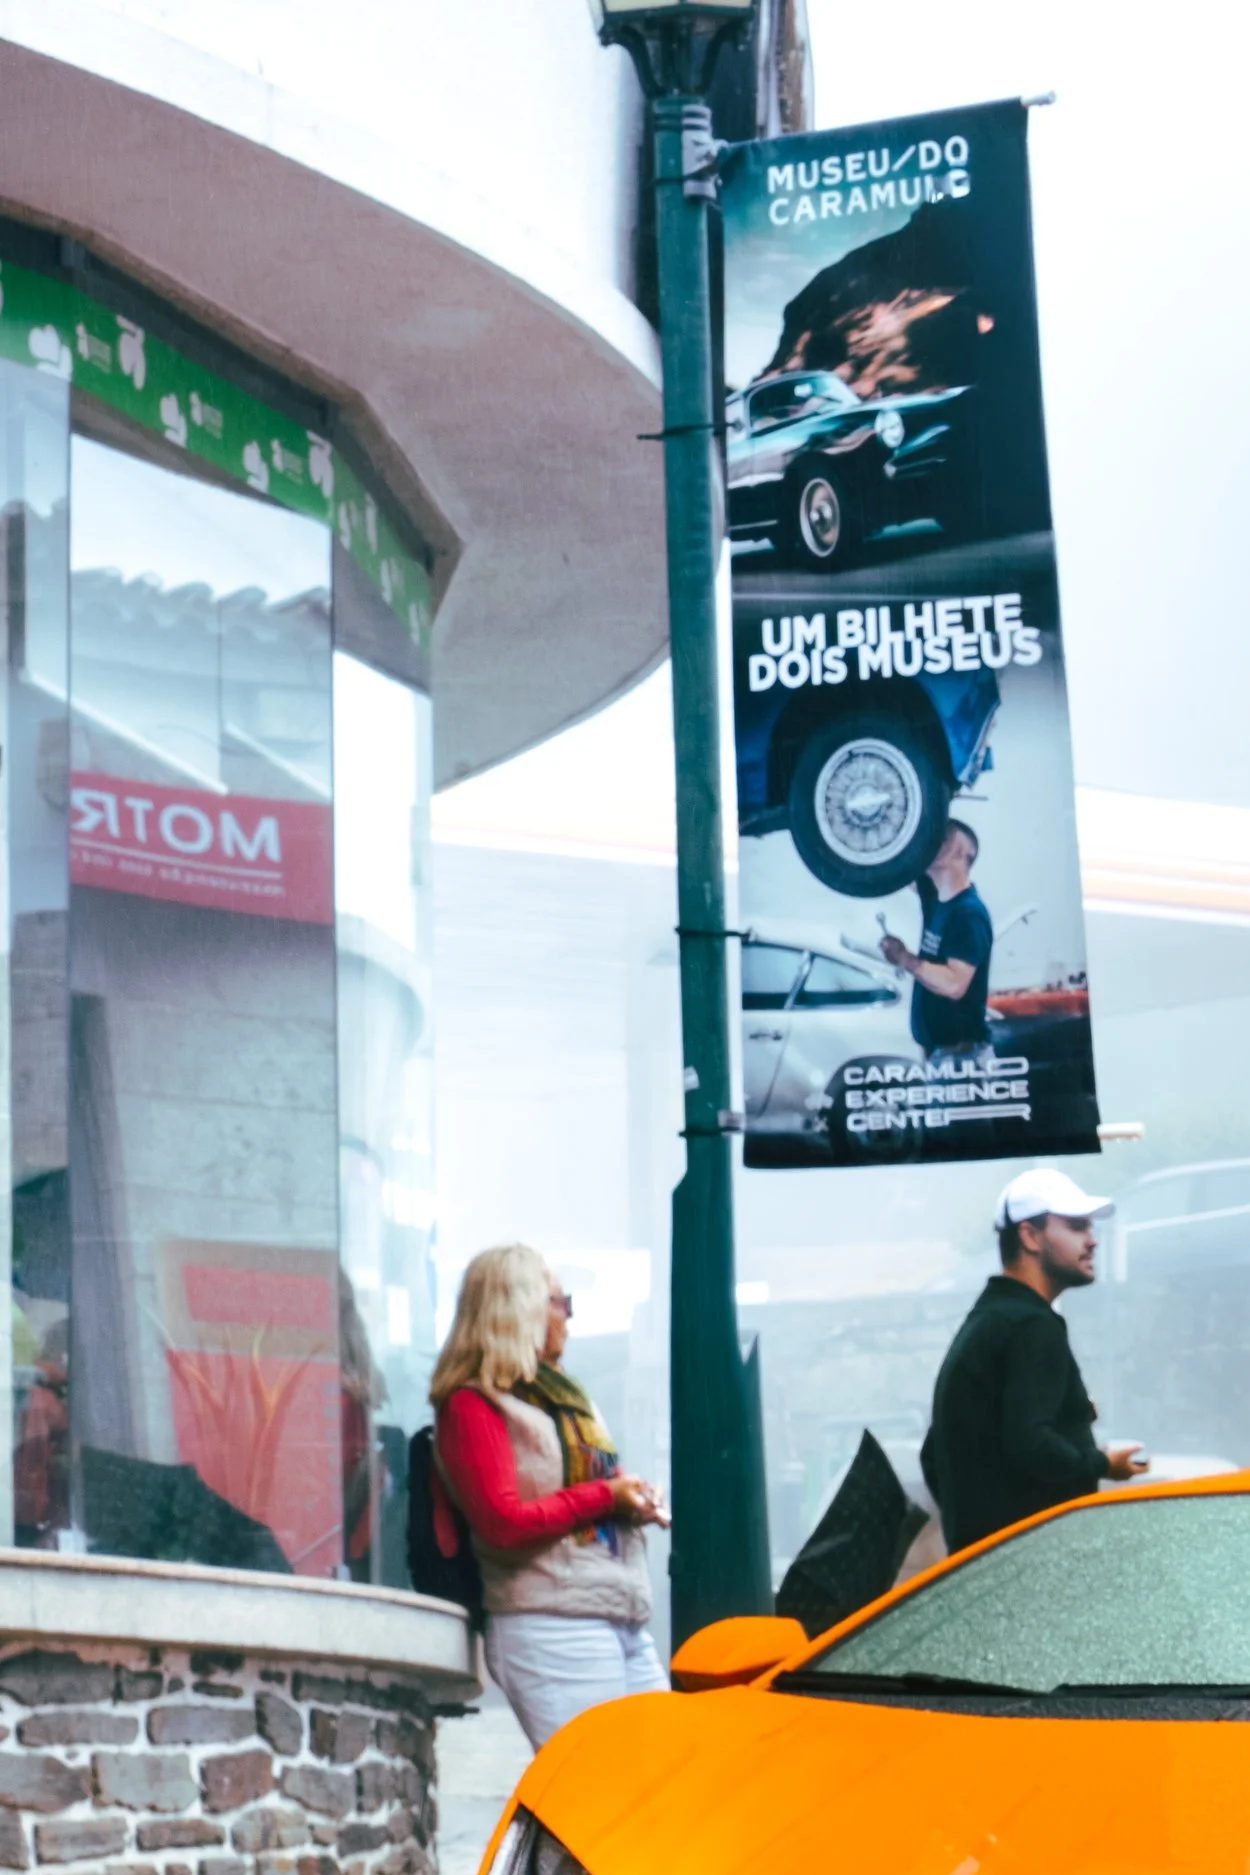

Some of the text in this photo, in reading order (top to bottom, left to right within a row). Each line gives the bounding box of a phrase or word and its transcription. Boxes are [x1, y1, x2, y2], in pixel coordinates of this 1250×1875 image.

[761, 592, 1024, 657] UM BILHETE
[748, 626, 1043, 692] DOIS MUSEUS
[843, 1056, 1029, 1085] CARAMULO
[845, 1080, 1029, 1108] EXPERIENCE
[846, 1103, 1032, 1131] CENTER
